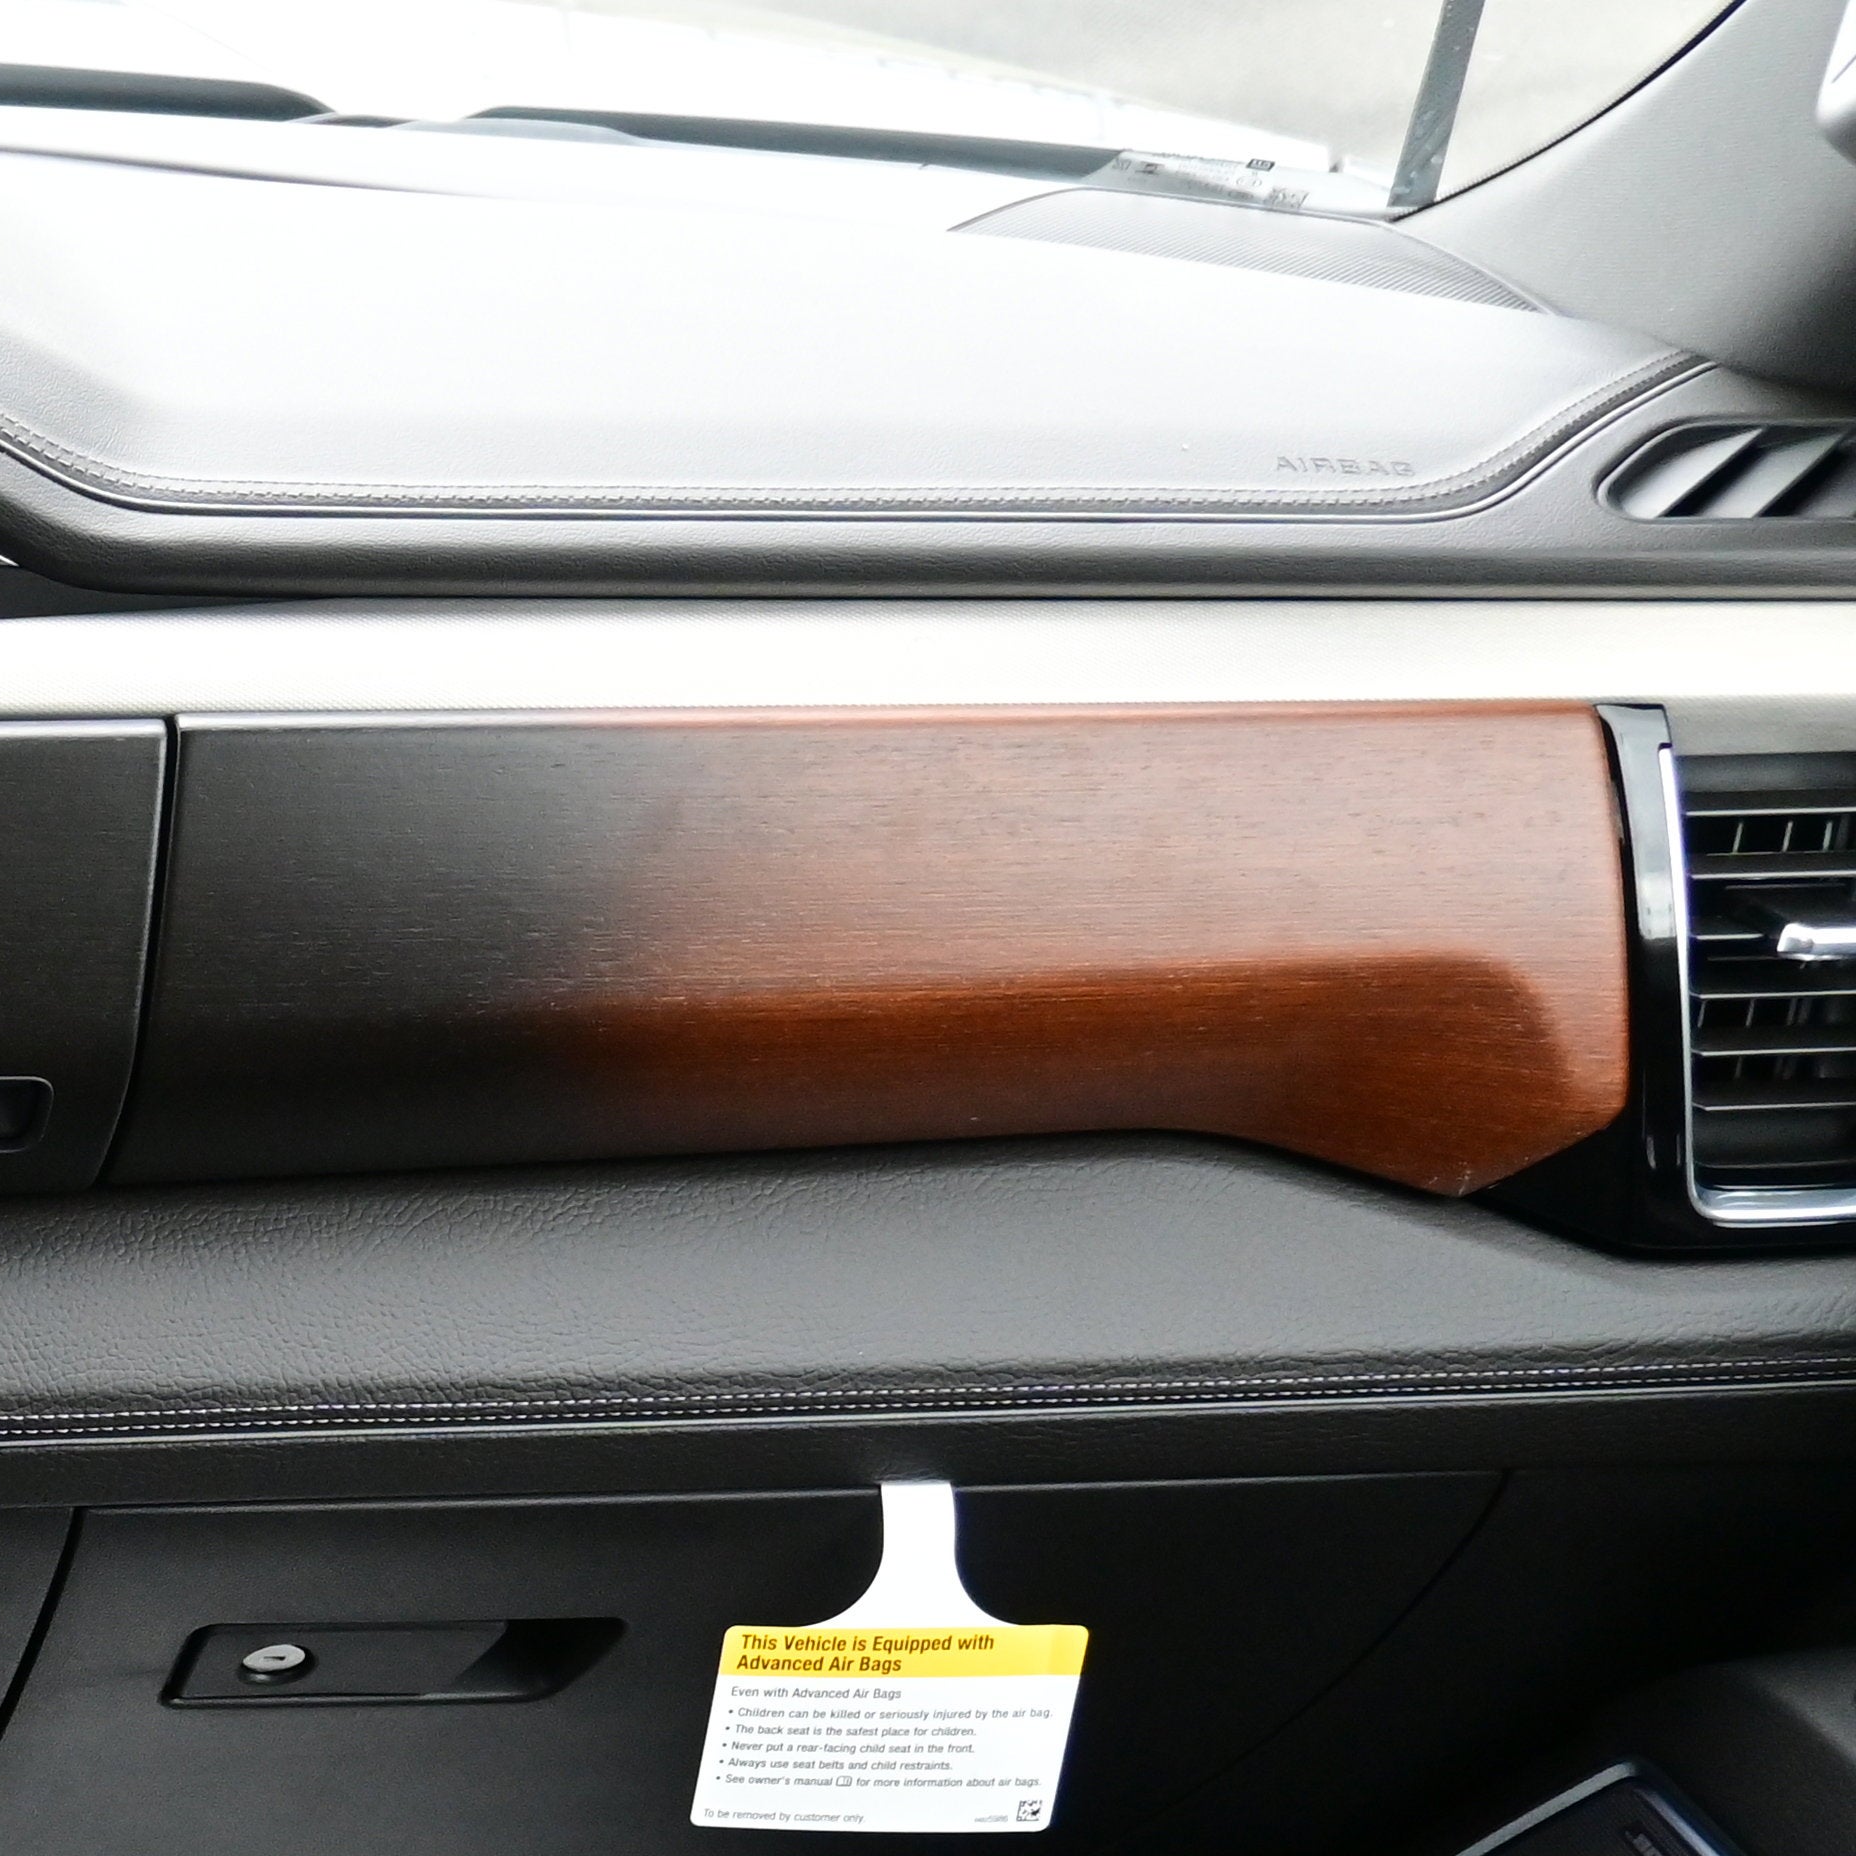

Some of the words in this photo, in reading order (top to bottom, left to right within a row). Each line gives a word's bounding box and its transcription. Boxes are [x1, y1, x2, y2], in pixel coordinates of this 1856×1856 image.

[1276, 455, 1414, 477] AIRBAG
[741, 1634, 778, 1650] This
[784, 1635, 847, 1651] Vehicle
[852, 1635, 867, 1651] is
[872, 1635, 953, 1654] Equipped
[958, 1634, 995, 1650] with
[736, 1655, 824, 1672] Advanced
[828, 1656, 854, 1672] Air
[859, 1656, 902, 1675] Bags
[731, 1686, 759, 1697] Even
[763, 1687, 788, 1698] with
[792, 1688, 850, 1699] Advanced
[853, 1688, 870, 1699] Air
[873, 1689, 902, 1701] Bags
[738, 1707, 785, 1718] Children
[788, 1710, 809, 1719] can
[812, 1710, 826, 1719] be
[830, 1709, 860, 1719] killed
[864, 1711, 876, 1719] or
[879, 1710, 929, 1720] seriously
[933, 1709, 971, 1721] injured
[975, 1710, 988, 1720] by
[992, 1709, 1009, 1718] the
[1012, 1709, 1026, 1718] air
[1030, 1709, 1053, 1719] bag.
[735, 1724, 754, 1734] The
[758, 1725, 783, 1735] back
[787, 1726, 810, 1735] seat
[813, 1726, 822, 1735] is
[826, 1726, 842, 1735] the
[845, 1726, 878, 1736] safest
[881, 1728, 910, 1738] place
[913, 1727, 928, 1736] for
[931, 1727, 977, 1736] children.
